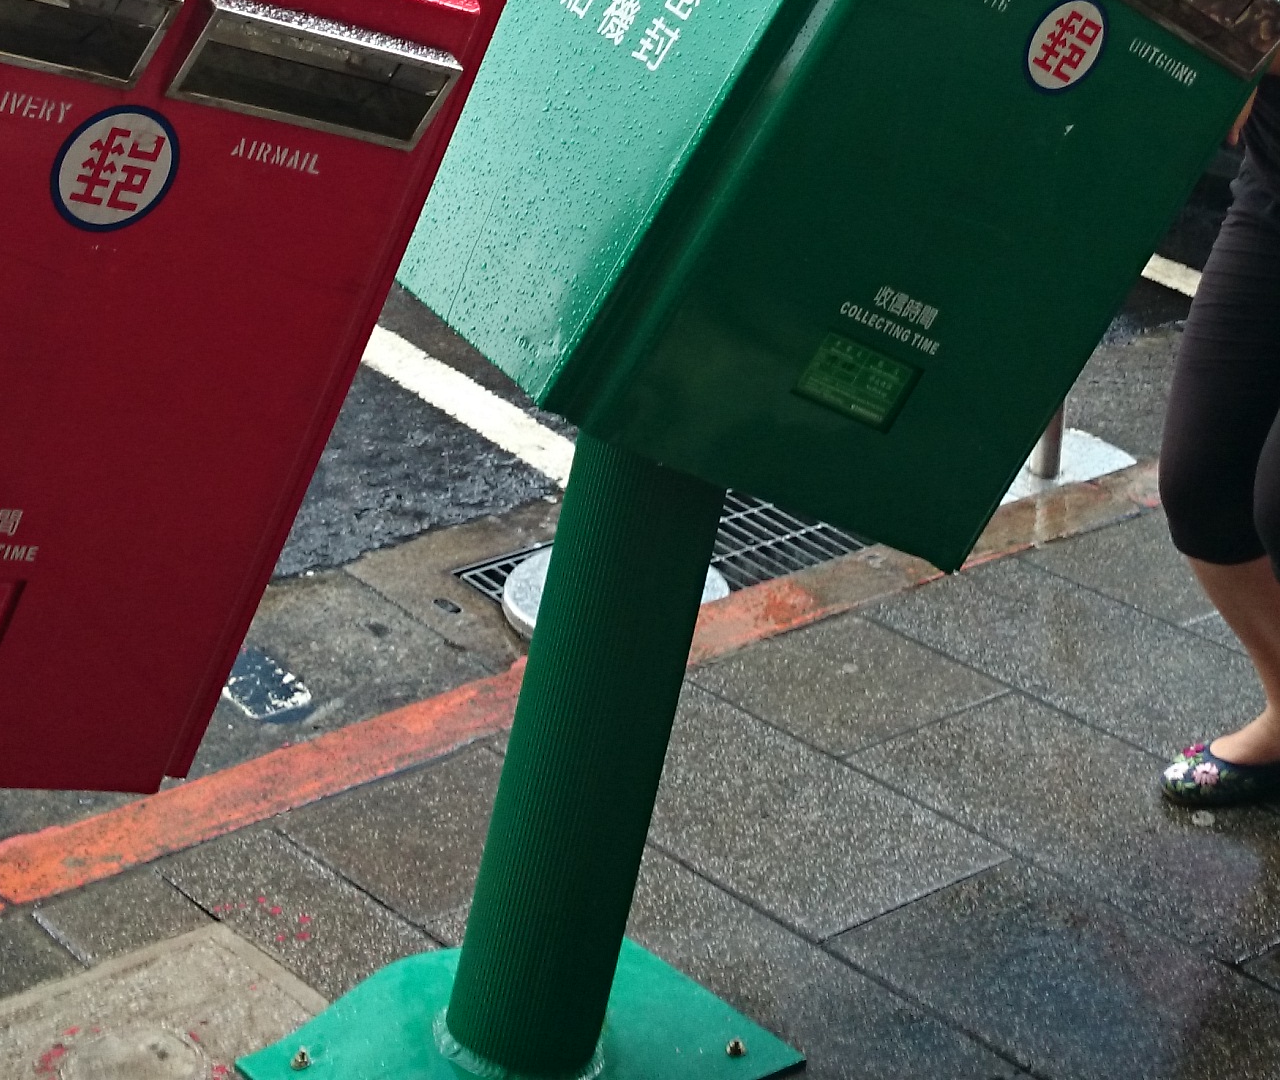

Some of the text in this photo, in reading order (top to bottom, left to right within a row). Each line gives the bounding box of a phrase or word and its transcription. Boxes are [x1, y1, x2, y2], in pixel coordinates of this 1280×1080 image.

[1129, 37, 1197, 87] OUTGOING
[230, 137, 320, 175] AIRMAIL
[840, 301, 940, 355] COLLECTING TIME
[874, 285, 939, 330] 收信時間
